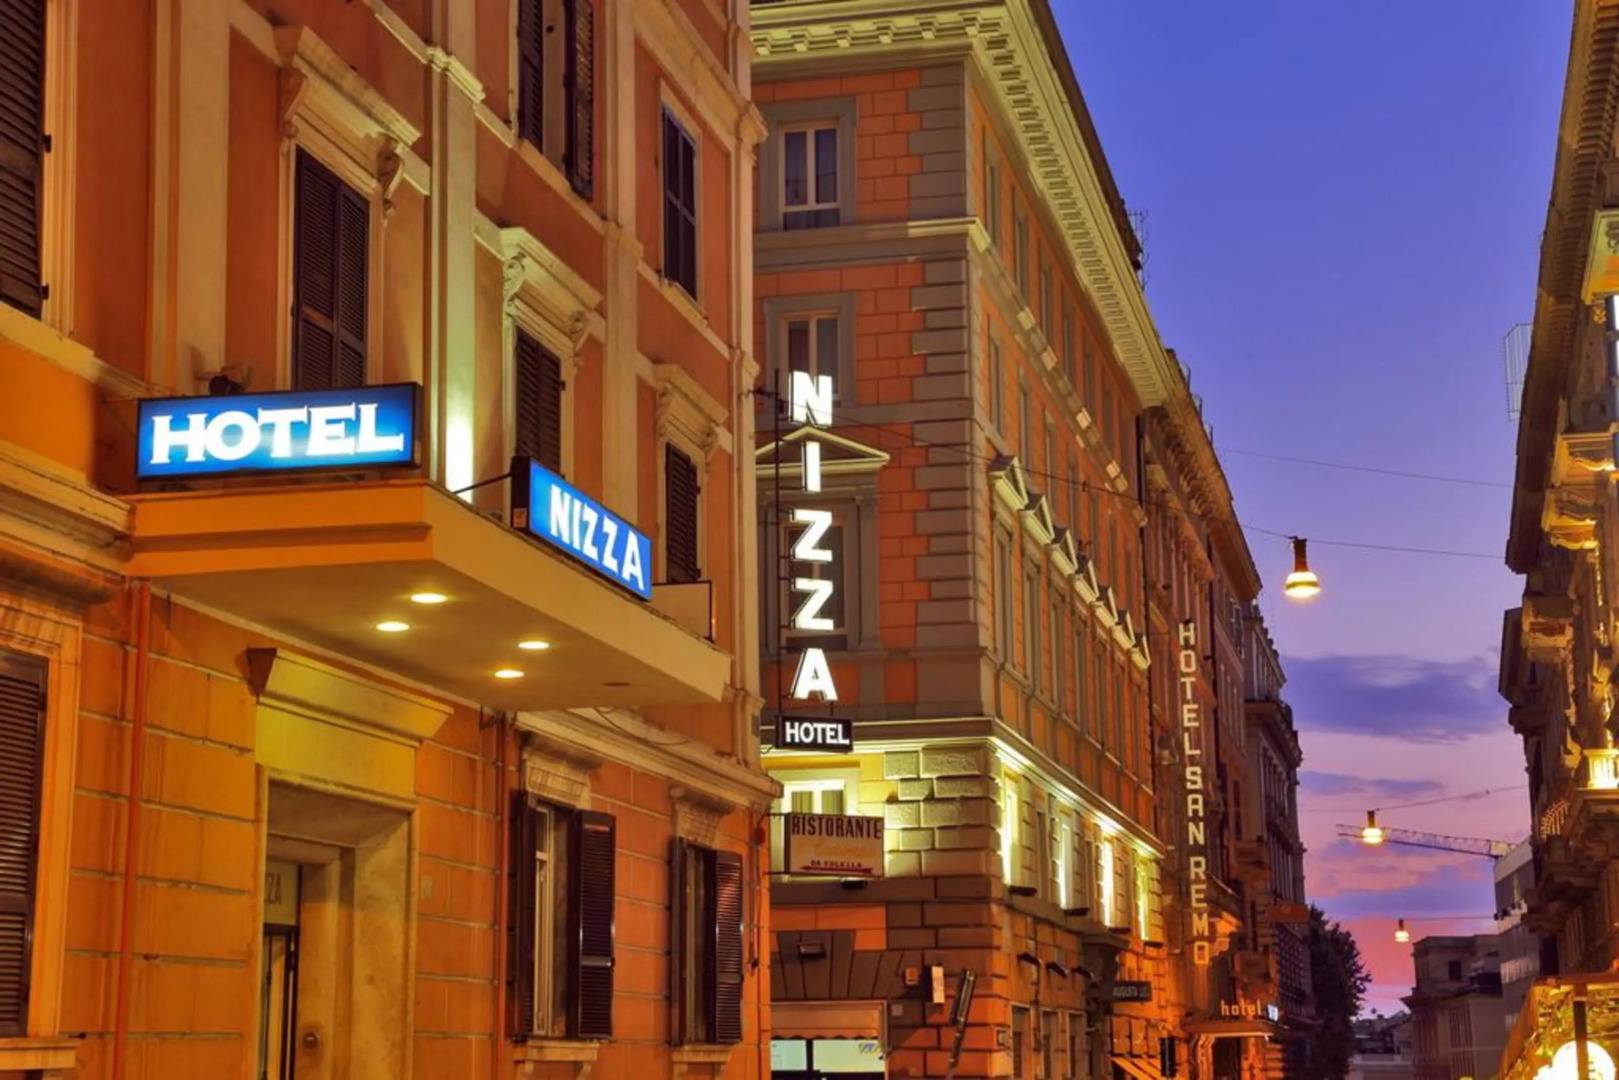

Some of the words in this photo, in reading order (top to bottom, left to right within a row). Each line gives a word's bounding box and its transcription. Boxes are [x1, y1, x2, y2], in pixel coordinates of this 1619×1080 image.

[150, 402, 404, 464] HOTEL
[550, 483, 644, 591] NIZZA
[789, 370, 838, 701] NIZZA
[1179, 622, 1200, 755] HOTEL
[785, 721, 850, 744] HOTEL
[791, 816, 881, 839] RISTORANTE
[1185, 766, 1204, 845] SAN
[1189, 856, 1210, 965] REMO
[1221, 1000, 1261, 1016] hotel
